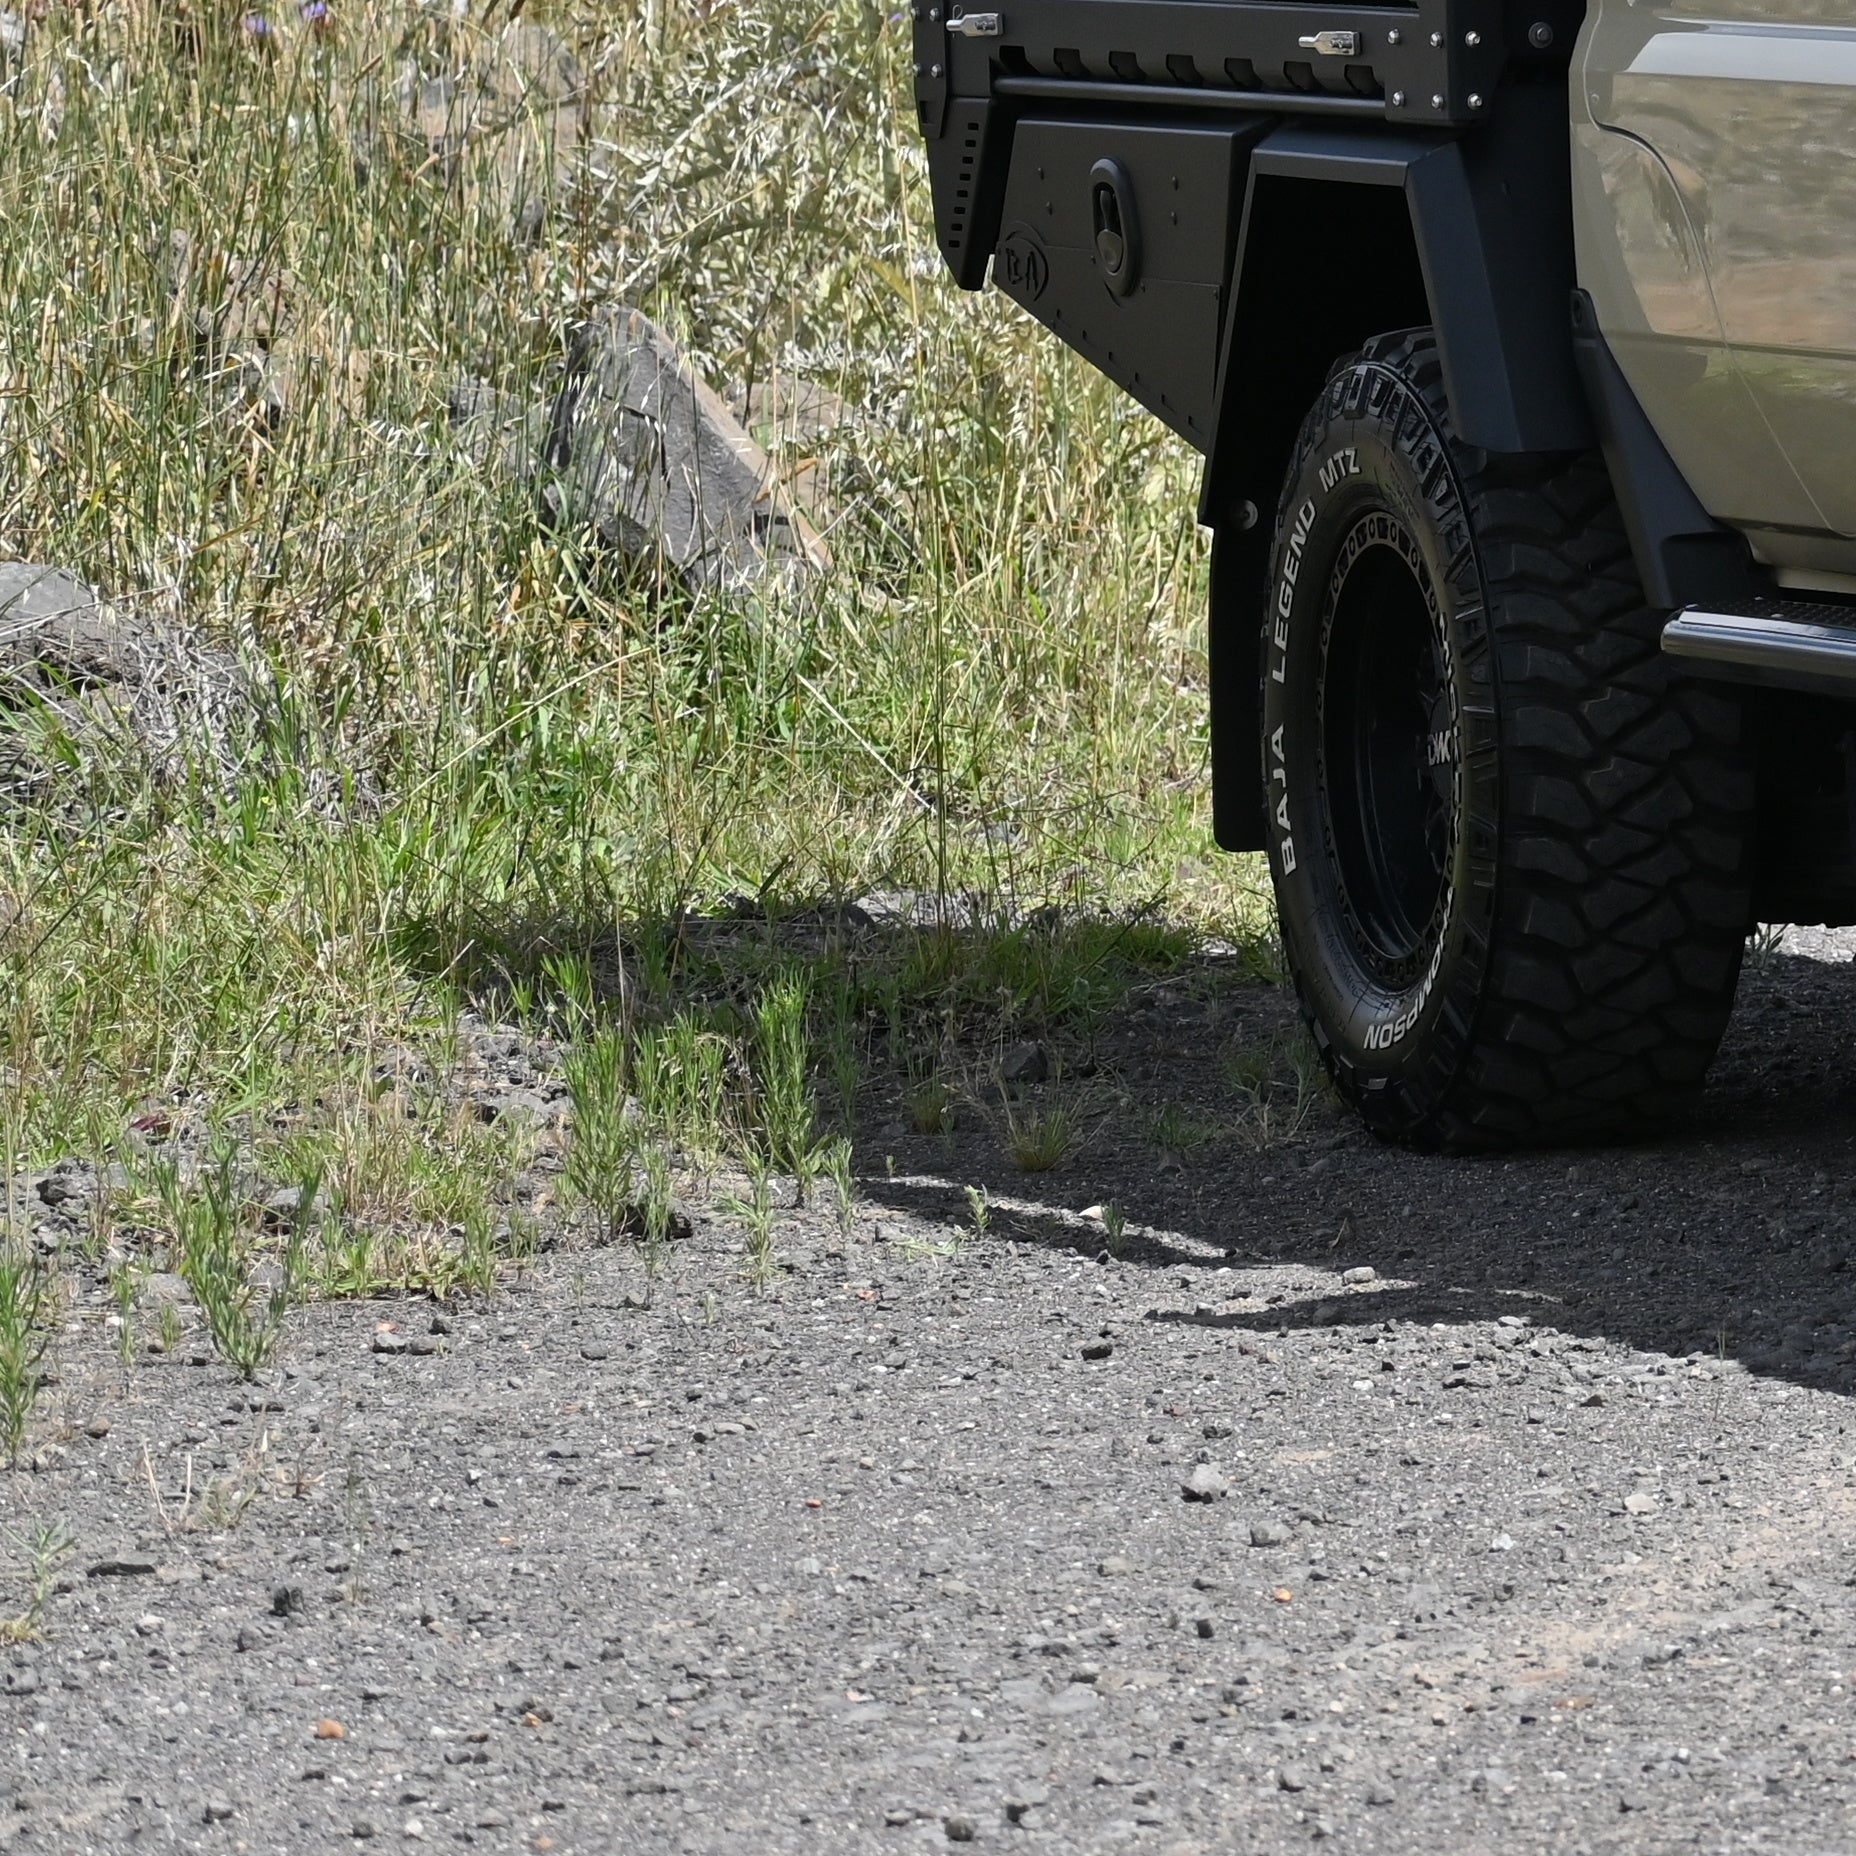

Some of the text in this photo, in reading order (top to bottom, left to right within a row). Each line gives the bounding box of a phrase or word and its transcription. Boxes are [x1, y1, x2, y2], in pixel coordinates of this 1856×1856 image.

[1271, 447, 1361, 877] BAJA LEGEND MTZ
